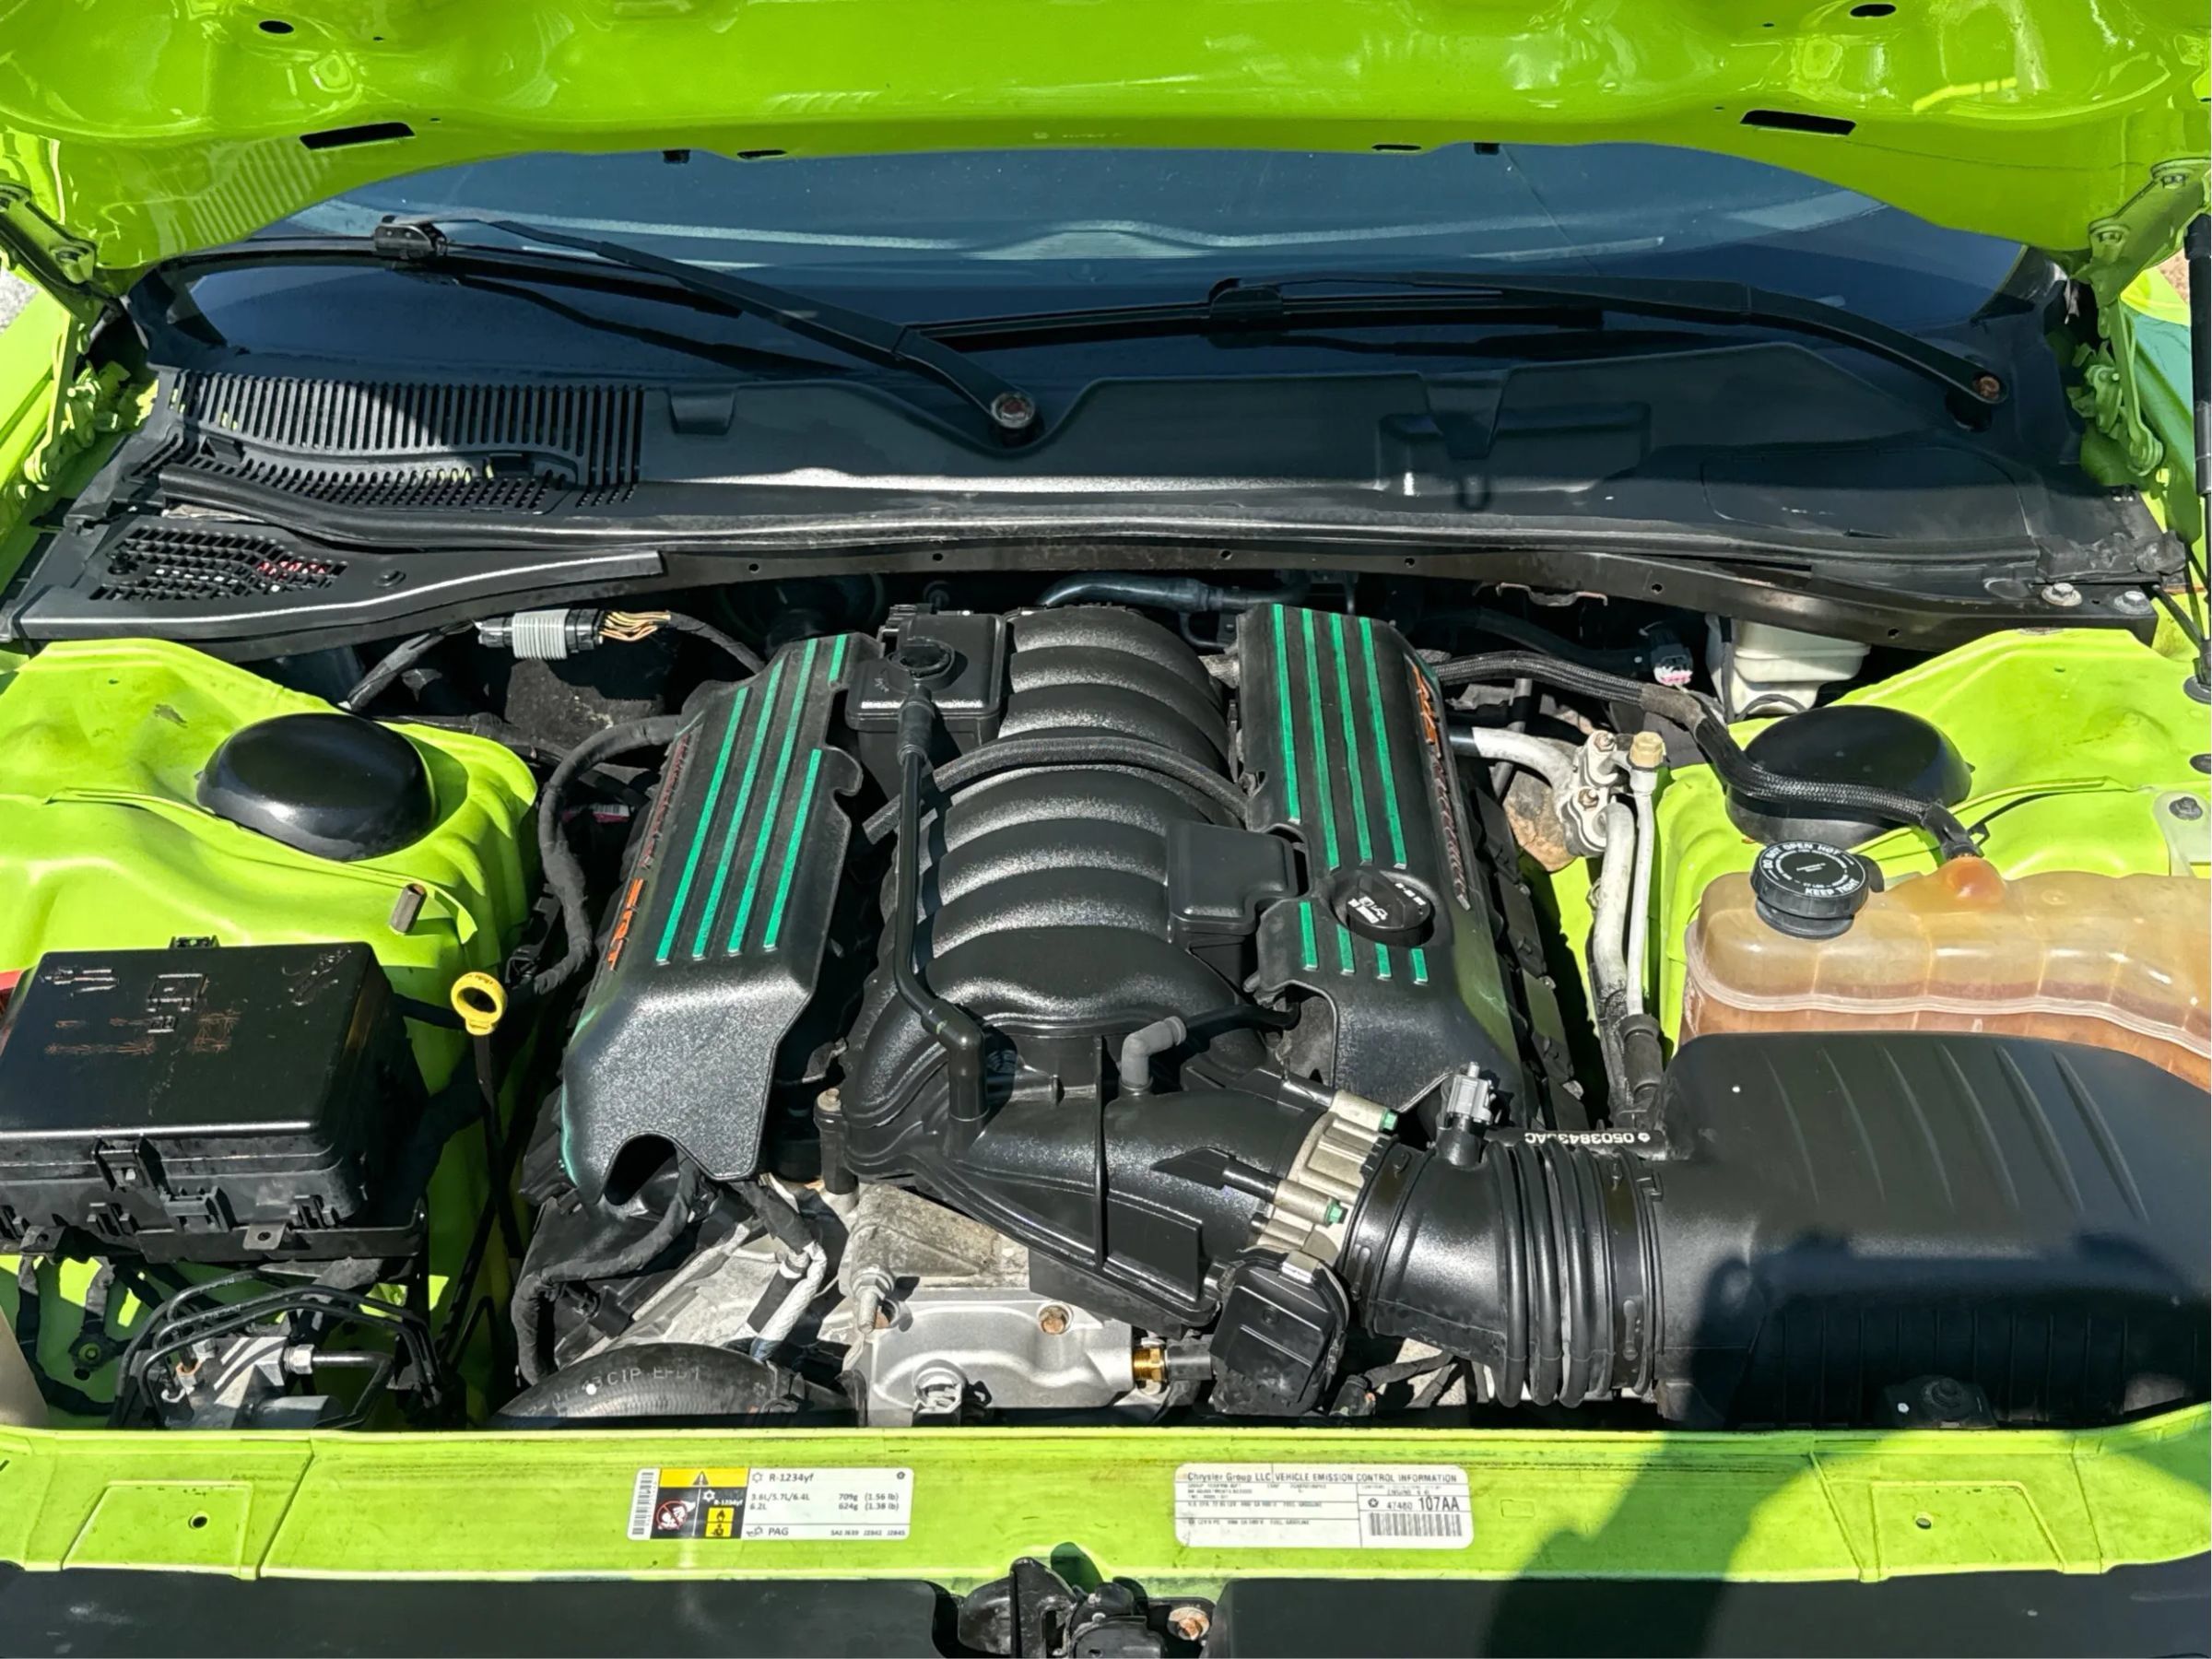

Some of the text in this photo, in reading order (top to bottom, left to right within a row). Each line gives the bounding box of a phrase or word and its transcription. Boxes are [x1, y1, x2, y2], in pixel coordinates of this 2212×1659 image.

[1764, 847, 1783, 859] NOT
[1817, 845, 1841, 855] HOT
[1762, 859, 1773, 869] DO
[1805, 878, 1860, 896] KEEP TIGHT
[770, 1473, 815, 1483] R-1234yf
[1187, 1473, 1271, 1482] Chrysler Group LLC
[1276, 1474, 1457, 1483] VEHICLE EMISSION CONTROL INFORMATION
[839, 1493, 858, 1501] 709g
[865, 1492, 885, 1501] (1.56
[888, 1492, 900, 1501] lb)
[749, 1502, 768, 1511] 6.2L
[839, 1502, 858, 1512] 624g
[888, 1502, 900, 1512] lb)
[1418, 1495, 1461, 1512] 107AA
[769, 1527, 789, 1536] PAG
